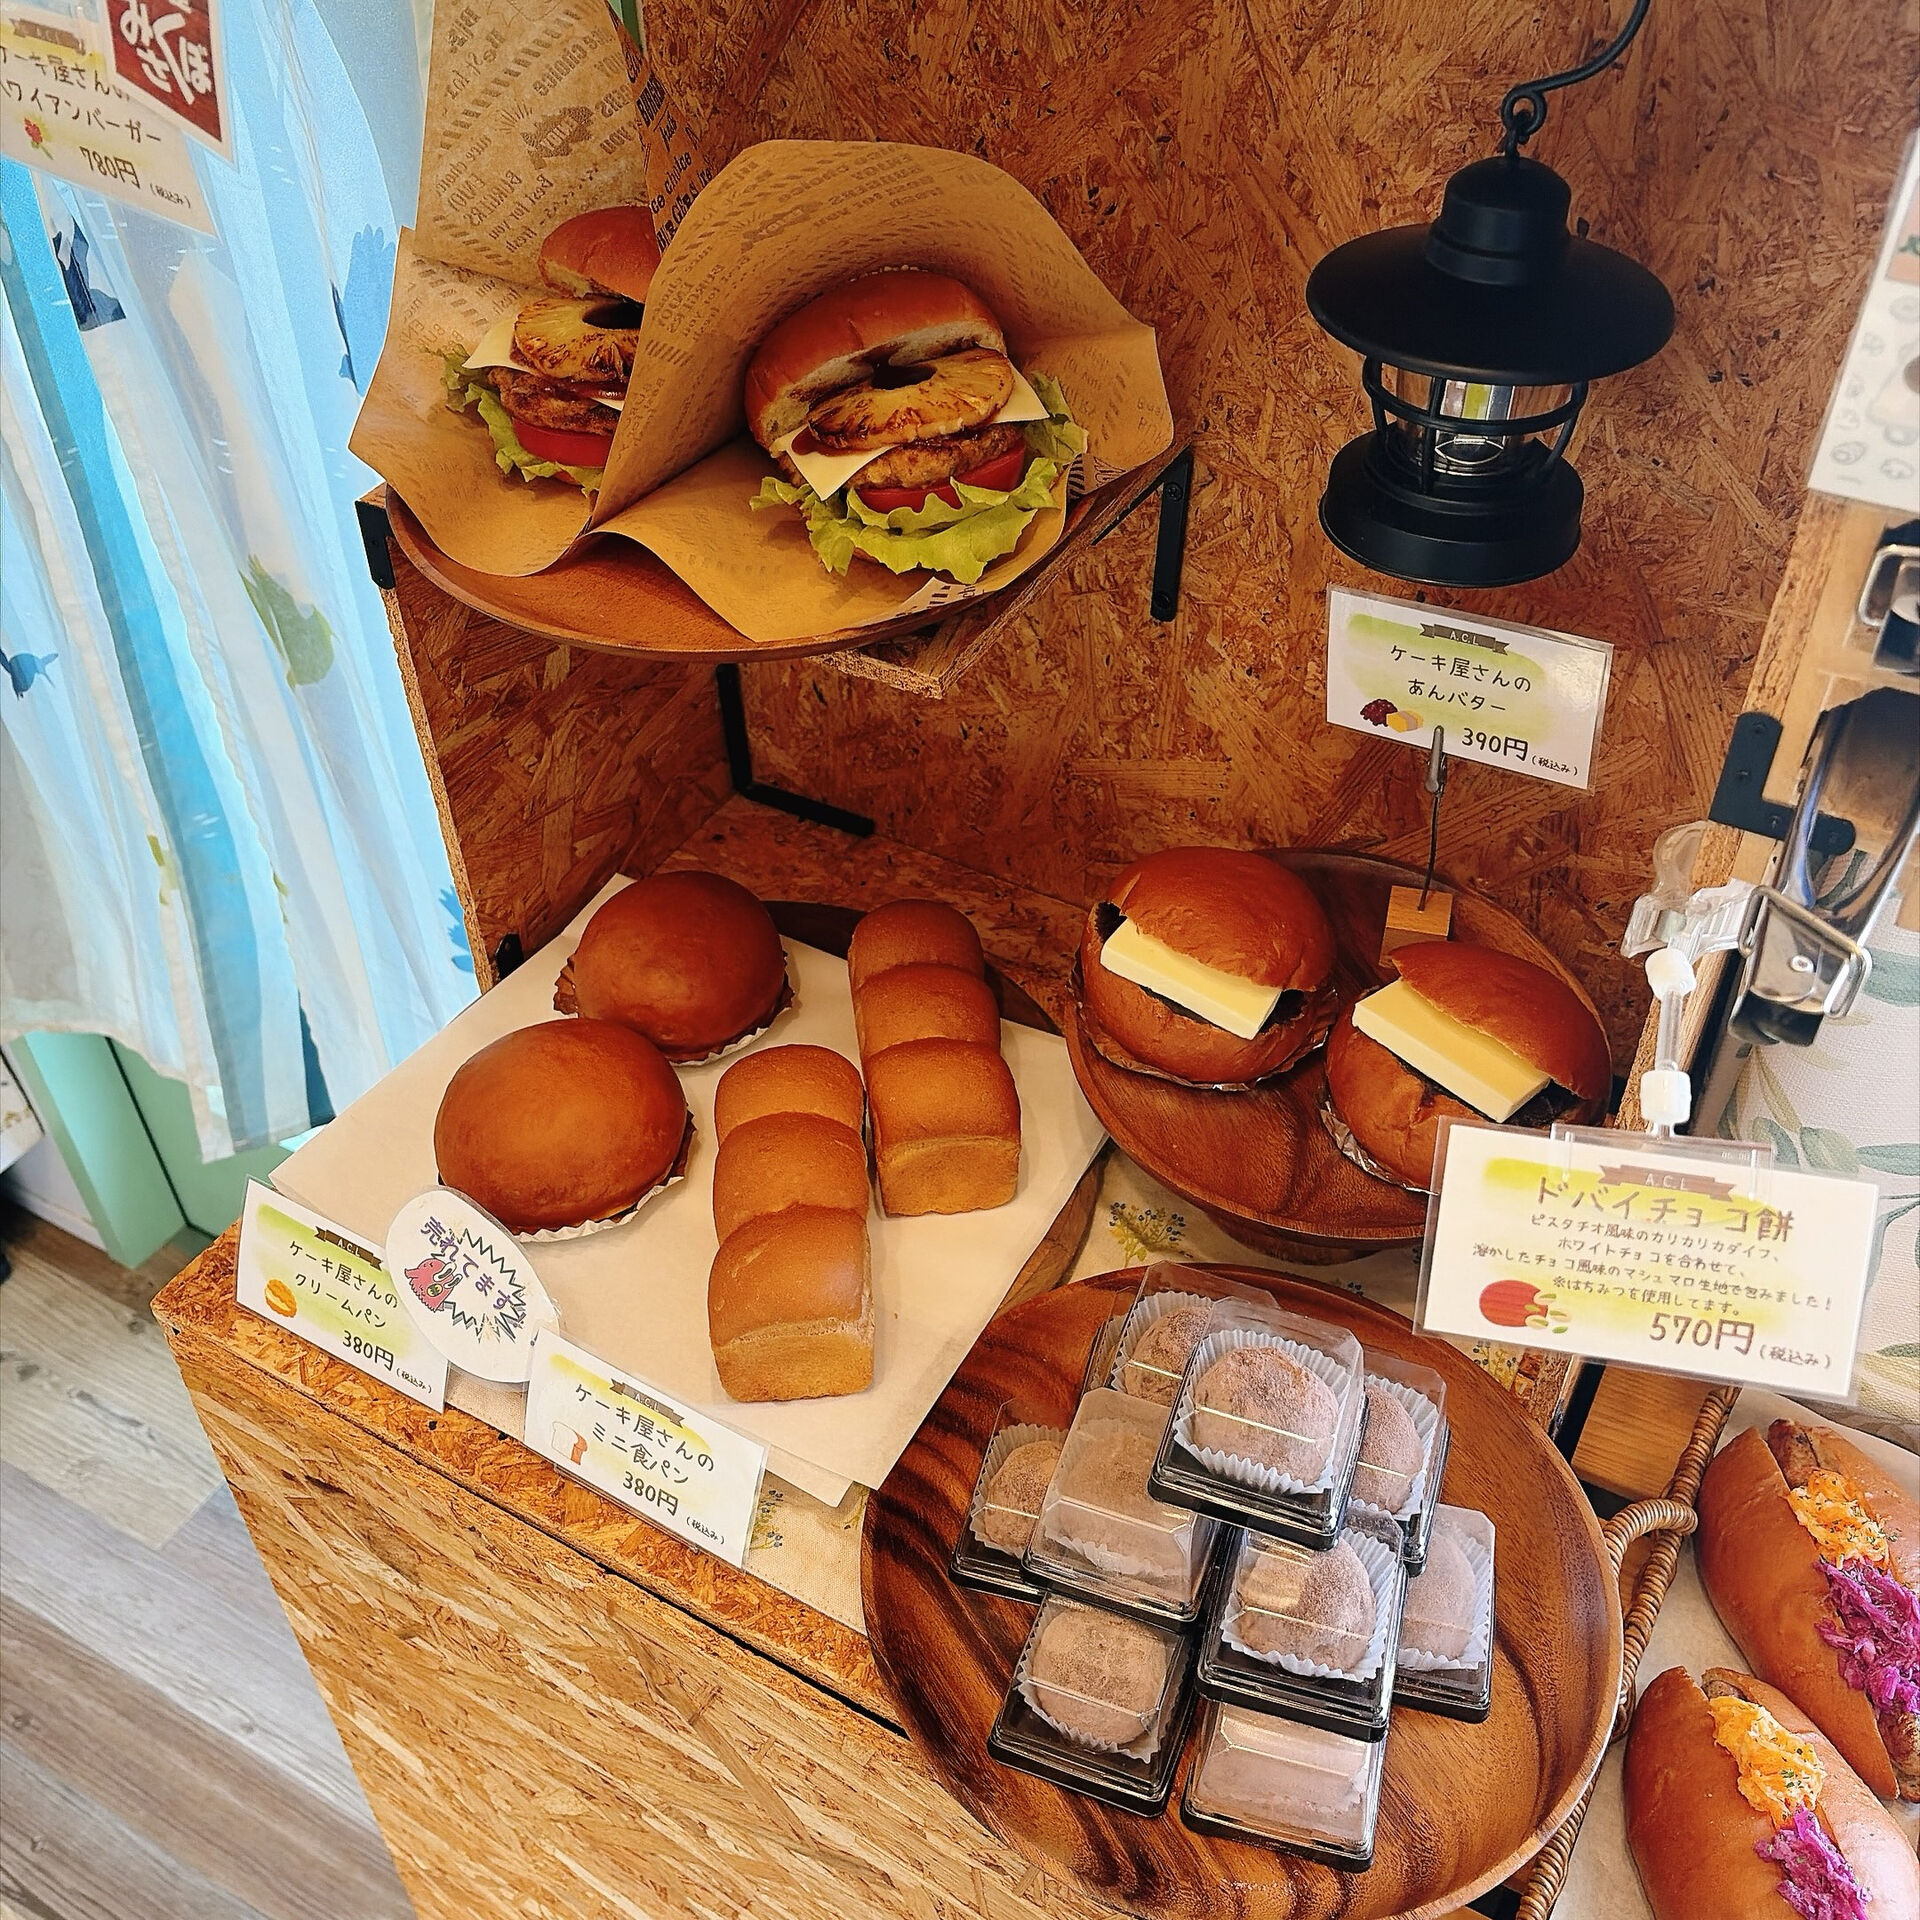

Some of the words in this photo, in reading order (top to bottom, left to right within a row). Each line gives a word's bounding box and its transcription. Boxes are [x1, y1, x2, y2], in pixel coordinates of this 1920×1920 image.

[79, 145, 141, 189] 780円
[1390, 644, 1531, 692] ケーキ屋さんの
[1408, 678, 1506, 712] あんバター
[1461, 727, 1530, 762] 390円
[1537, 1176, 1794, 1243] ドバイチョコ餅
[1531, 1213, 1779, 1262] ピスタチオ風味のカリカリカダイフ、
[1558, 1237, 1744, 1277] ホワイトチョコを合わせて、
[289, 1240, 398, 1309] ケーキ屋さんの
[295, 1273, 387, 1329] クリームパン
[342, 1330, 395, 1371] 380円
[1648, 1312, 1755, 1356] 570円
[575, 1383, 714, 1472] ケーキ屋さんの
[592, 1422, 689, 1484] ミニ食パン
[622, 1472, 679, 1516] 380円
